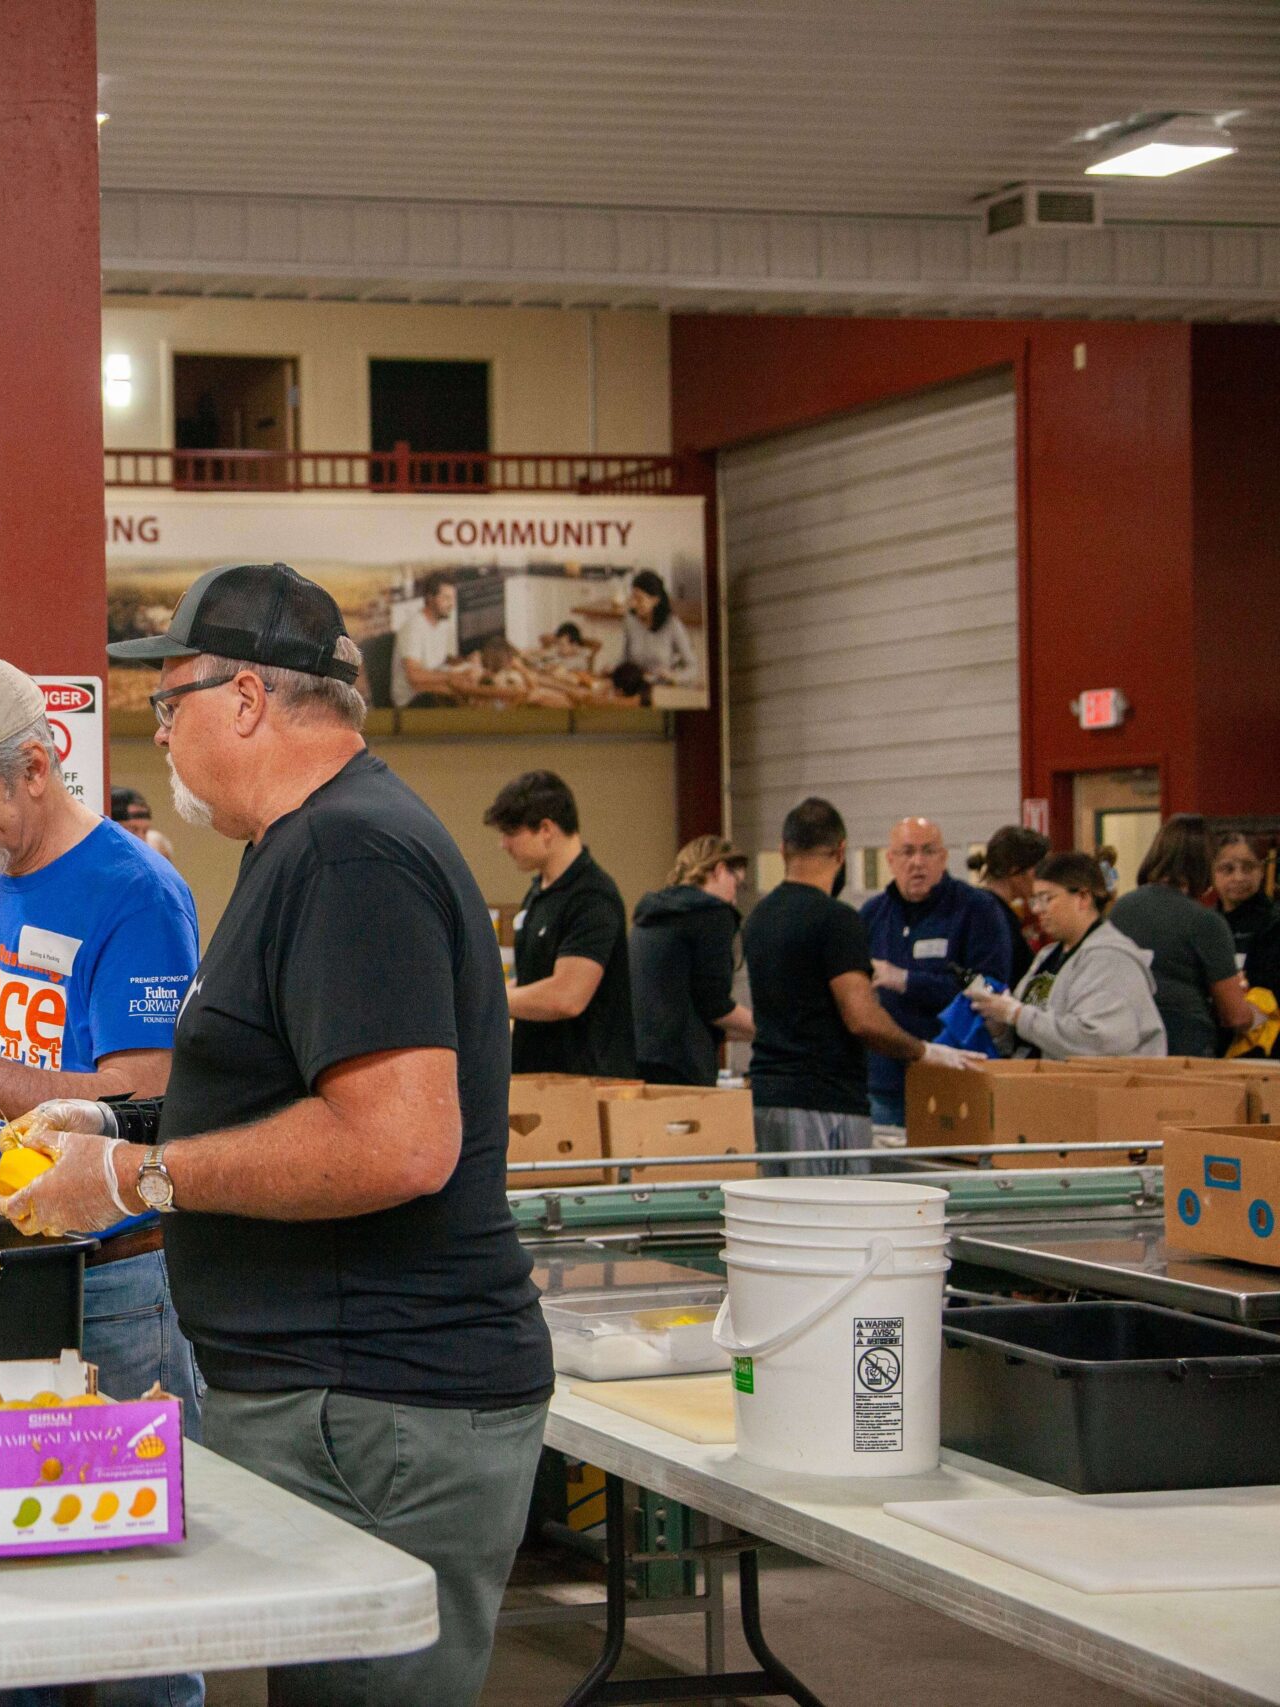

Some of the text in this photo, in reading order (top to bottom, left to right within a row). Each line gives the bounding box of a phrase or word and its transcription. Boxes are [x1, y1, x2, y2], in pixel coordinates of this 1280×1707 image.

[435, 518, 633, 547] COMMUNITY
[129, 974, 189, 984] PREMIER SPONSOR
[144, 986, 178, 999] Fulton
[864, 1319, 902, 1328] WARNING
[872, 1328, 896, 1337] AVISO
